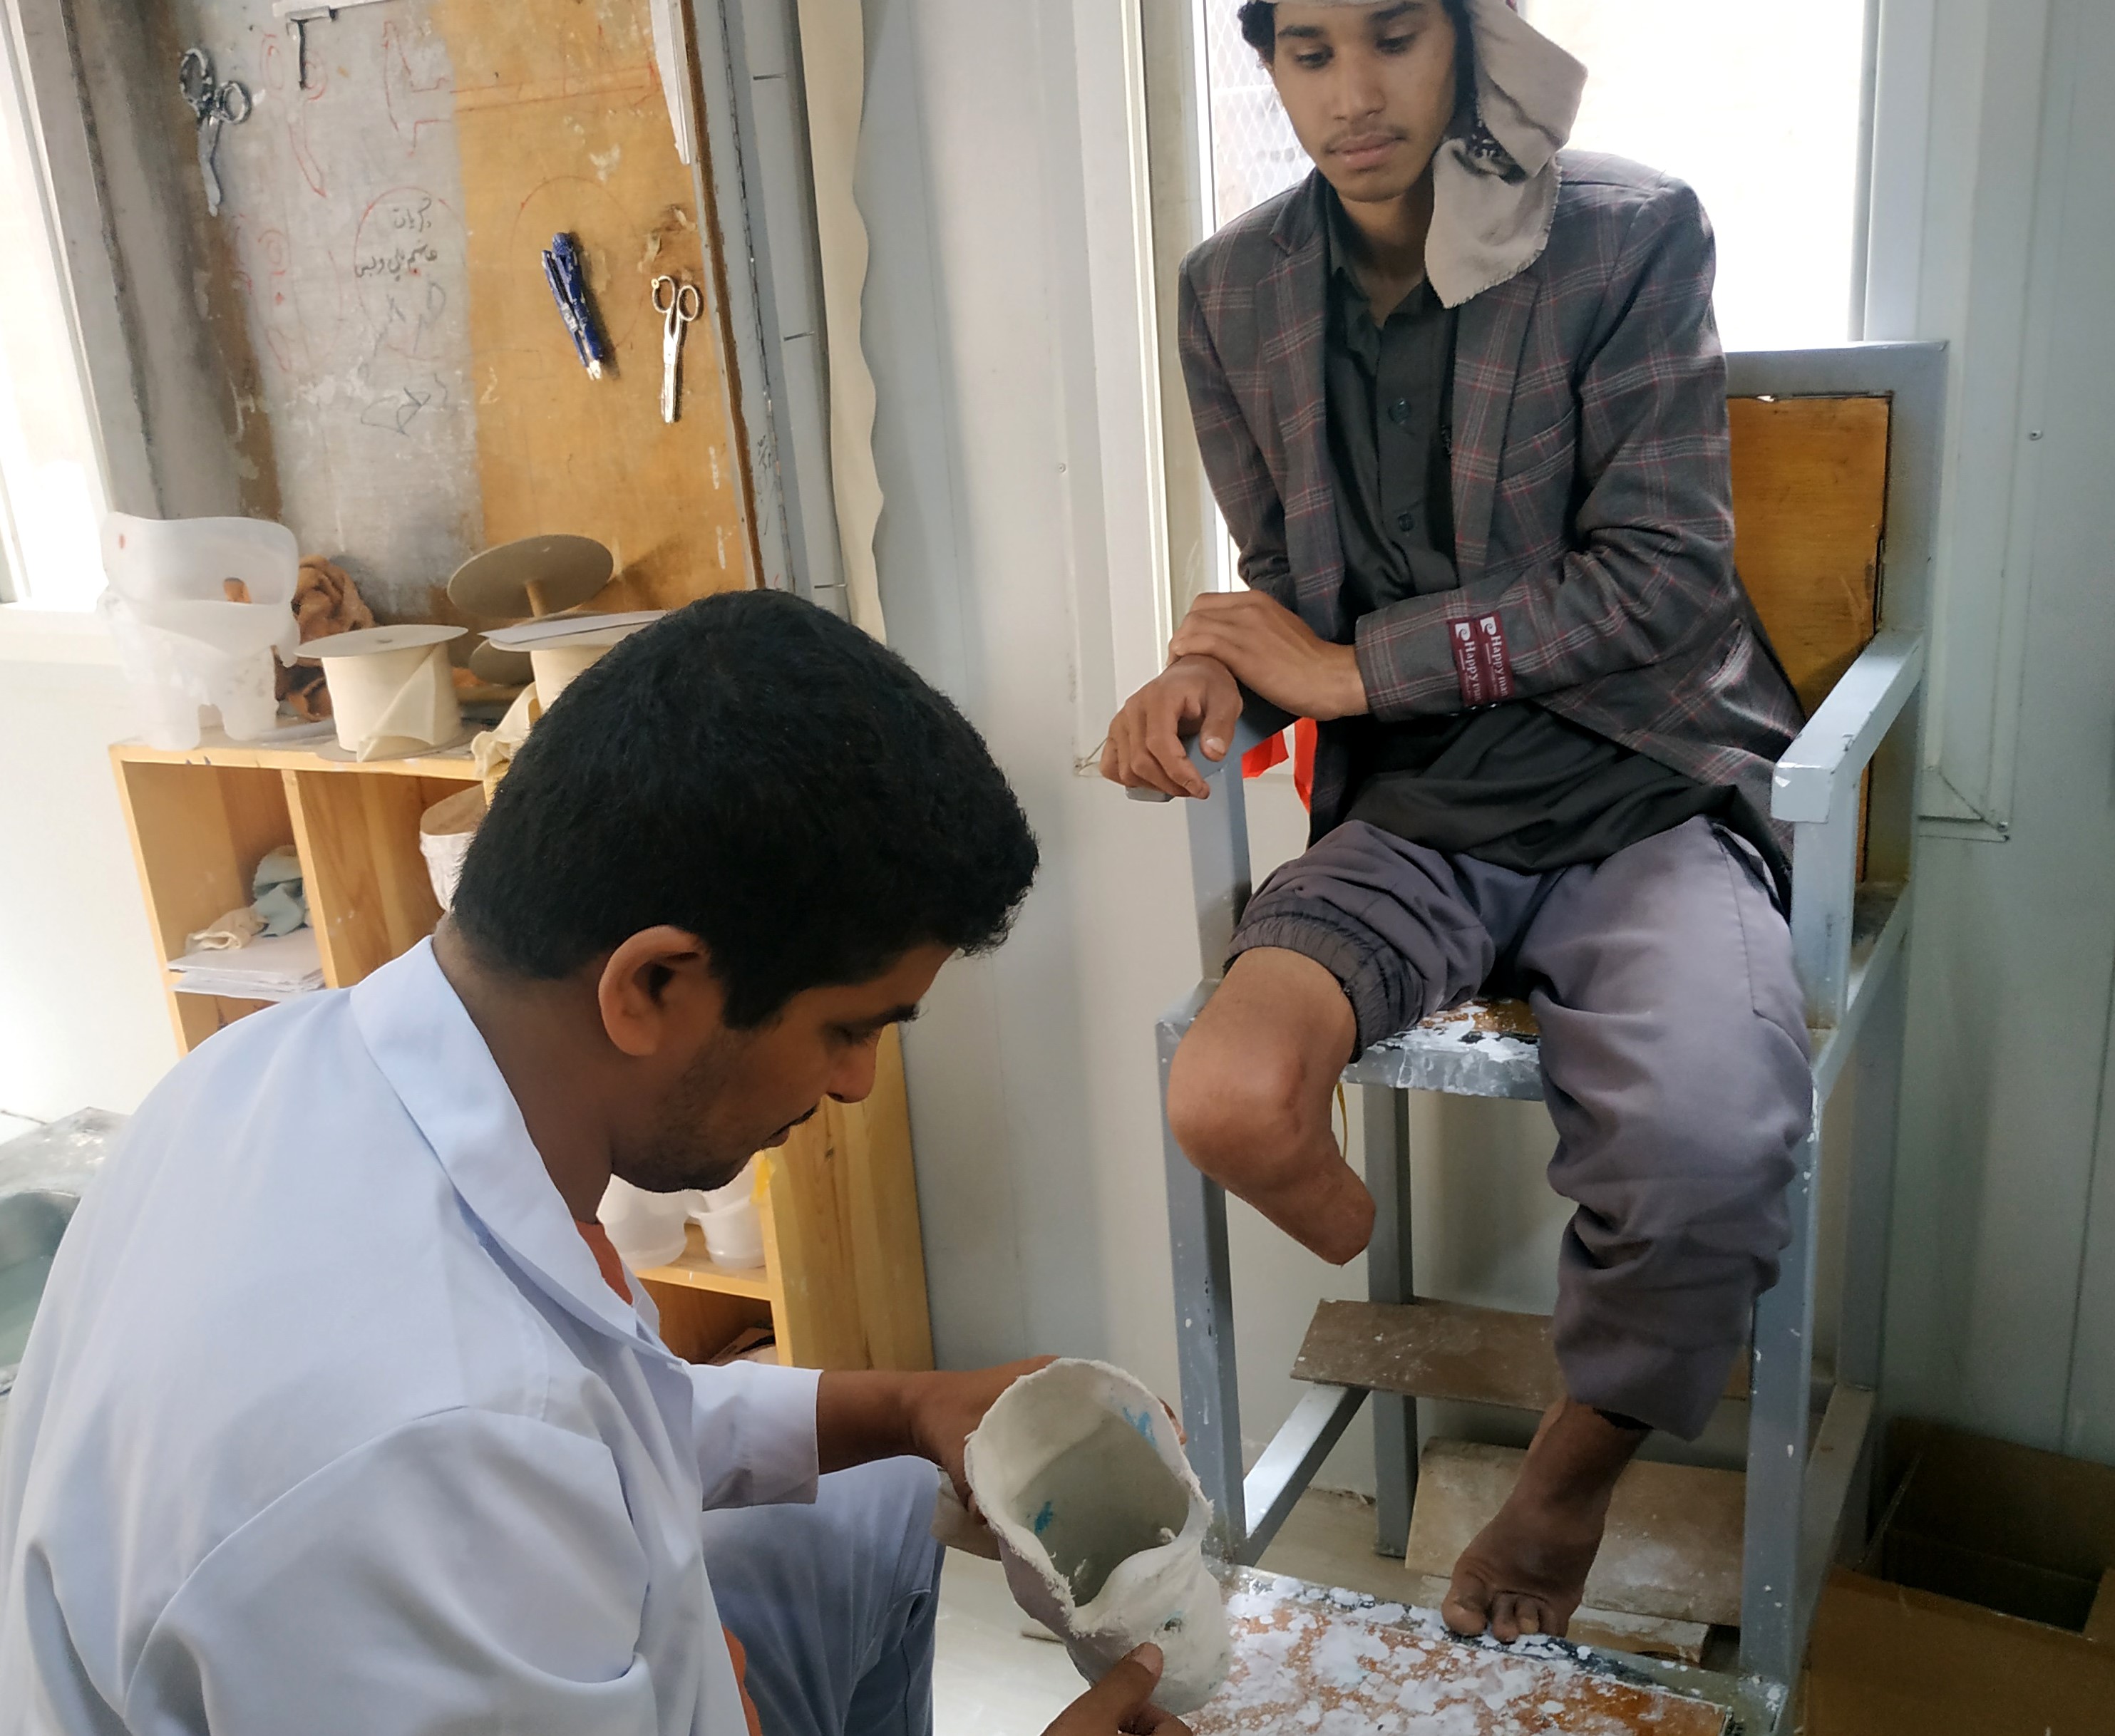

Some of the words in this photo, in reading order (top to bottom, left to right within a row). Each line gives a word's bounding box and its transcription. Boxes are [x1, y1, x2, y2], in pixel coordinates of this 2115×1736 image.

[1464, 641, 1478, 681] Happy
[1491, 635, 1505, 675] Happy
[1498, 676, 1508, 697] man
